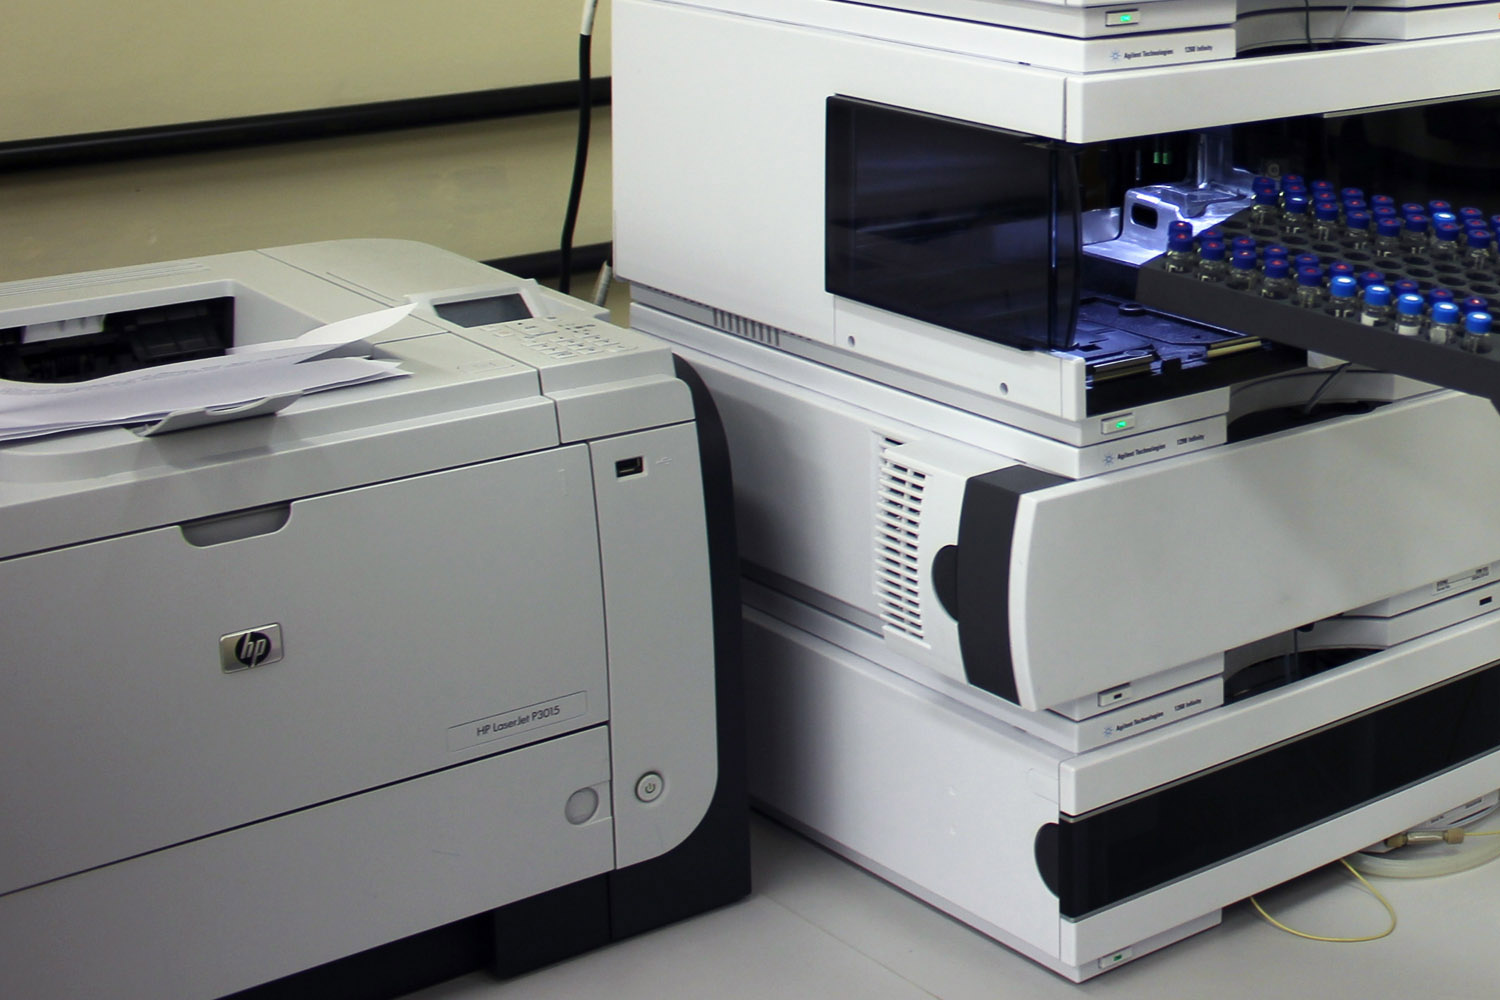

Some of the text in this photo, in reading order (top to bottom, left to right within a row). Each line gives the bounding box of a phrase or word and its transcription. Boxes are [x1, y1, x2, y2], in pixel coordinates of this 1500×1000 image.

[240, 632, 267, 668] hp
[476, 705, 561, 736] HP LaserJet P3015
